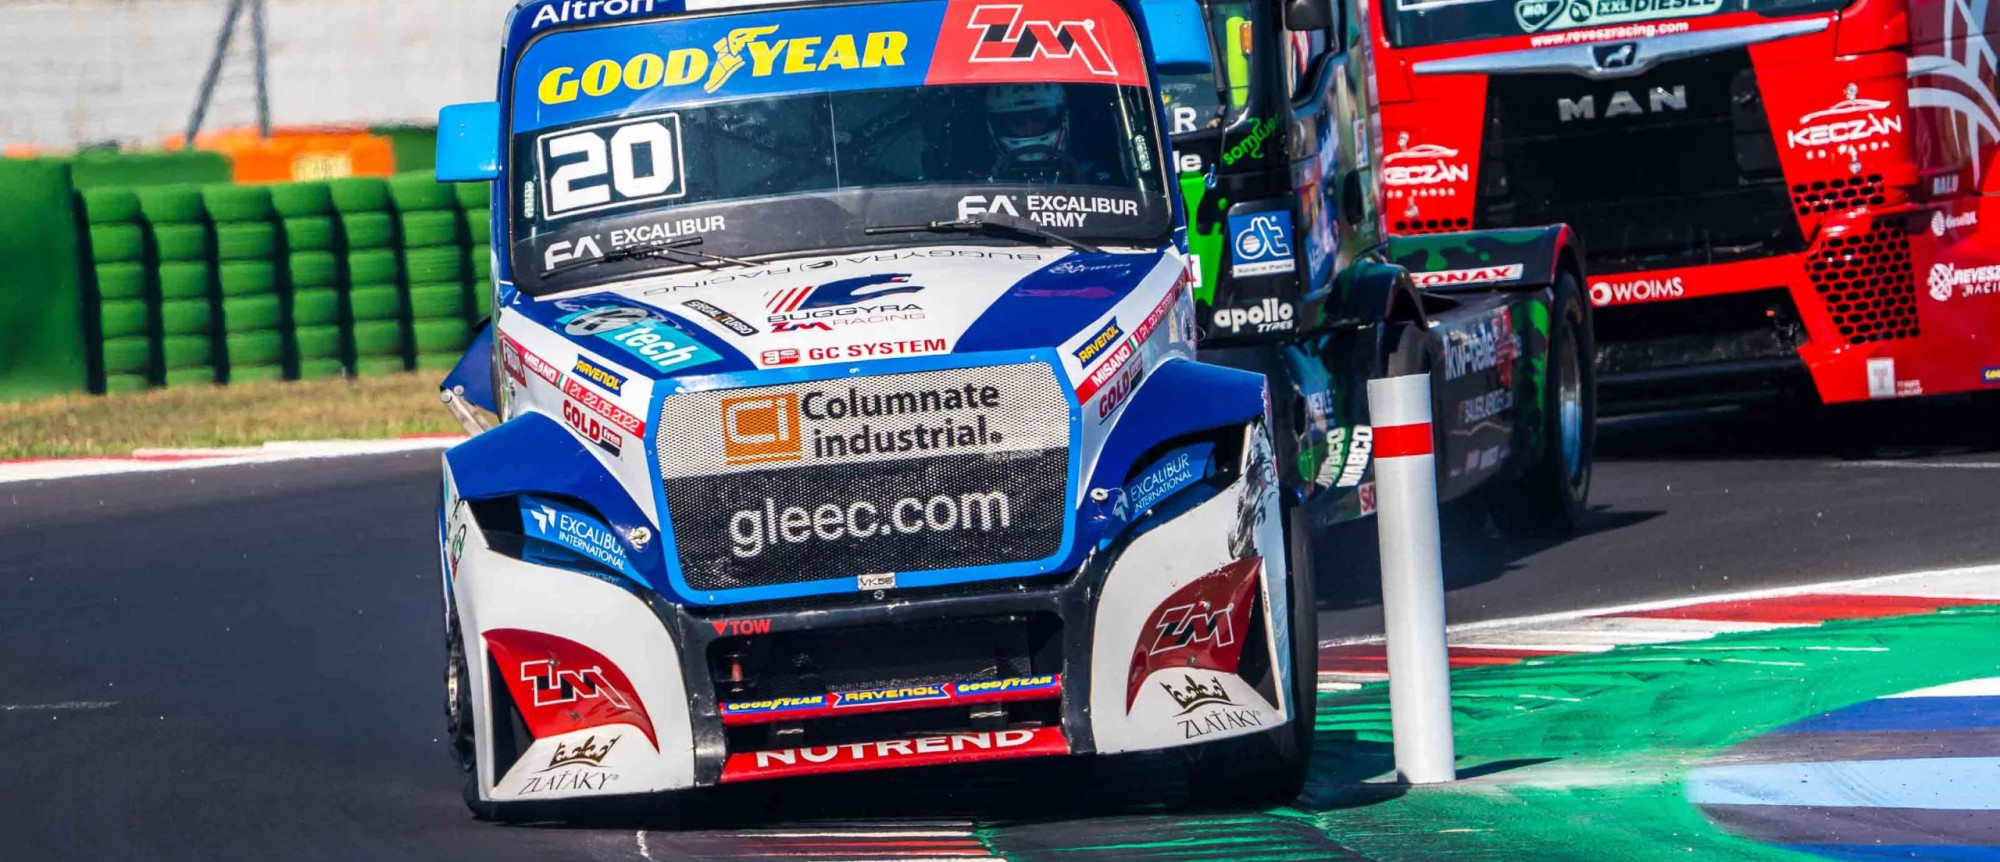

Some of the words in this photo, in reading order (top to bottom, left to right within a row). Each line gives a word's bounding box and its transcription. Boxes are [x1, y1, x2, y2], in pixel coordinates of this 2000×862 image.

[531, 0, 653, 29] Altron
[1531, 21, 1688, 47] www.reveszracing.com
[538, 29, 908, 105] GOODYEAR
[1558, 85, 1687, 121] MAN
[550, 122, 674, 212] 20
[1027, 195, 1138, 216] EXCALIBUR
[1030, 211, 1087, 227] ARMY
[611, 215, 725, 247] EXCALIBUR
[1612, 276, 1684, 302] WOIMS
[721, 315, 753, 334] TURBO
[767, 304, 924, 323] BUGGYRA
[832, 313, 926, 326] RACING
[1213, 298, 1293, 332] apollo
[614, 326, 699, 366] tech
[809, 346, 840, 360] GC
[848, 338, 946, 357] SYSTEM
[1078, 325, 1119, 362] RAVENOL
[523, 351, 557, 383] MISANO
[576, 359, 621, 391] RAVENOL
[1091, 345, 1131, 388] MISANO
[801, 382, 1000, 421] Columnate
[1099, 370, 1131, 419] GOLD
[562, 400, 600, 442] GOLD
[1336, 424, 1373, 488] WABCO
[1131, 452, 1190, 502] EXCALIBUR
[1134, 469, 1193, 513] INTERNATIONAL
[728, 489, 1012, 559] gleec.com
[558, 532, 625, 571] INTERNATIONAL
[731, 619, 771, 635] TOW
[728, 695, 823, 712] GOODYEAR
[844, 685, 938, 702] RAVENOL
[958, 675, 1053, 692] GOODYEAR
[755, 729, 1034, 769] NUTREND
